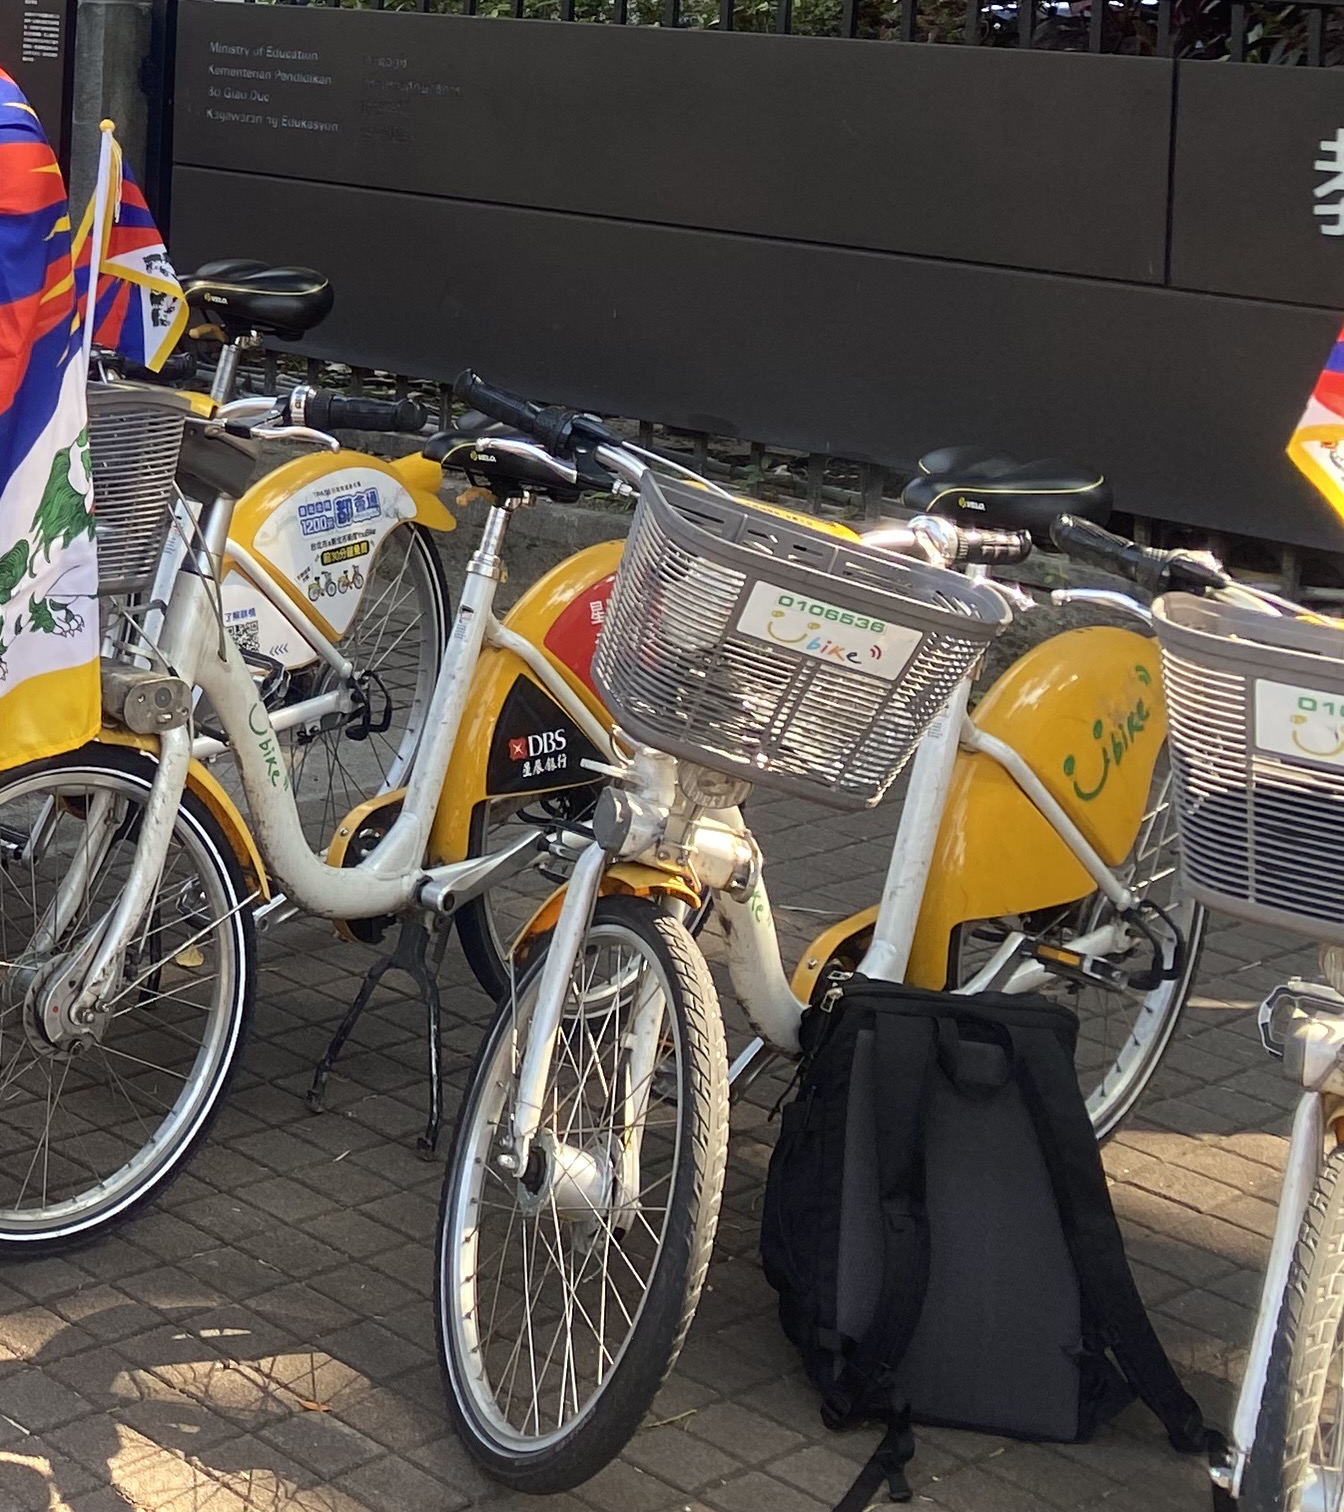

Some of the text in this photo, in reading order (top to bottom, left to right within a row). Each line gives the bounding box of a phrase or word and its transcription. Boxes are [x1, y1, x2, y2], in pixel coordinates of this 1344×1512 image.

[210, 42, 318, 61] Ministry of Education
[778, 594, 886, 634] 0106536
[528, 728, 567, 757] DBS
